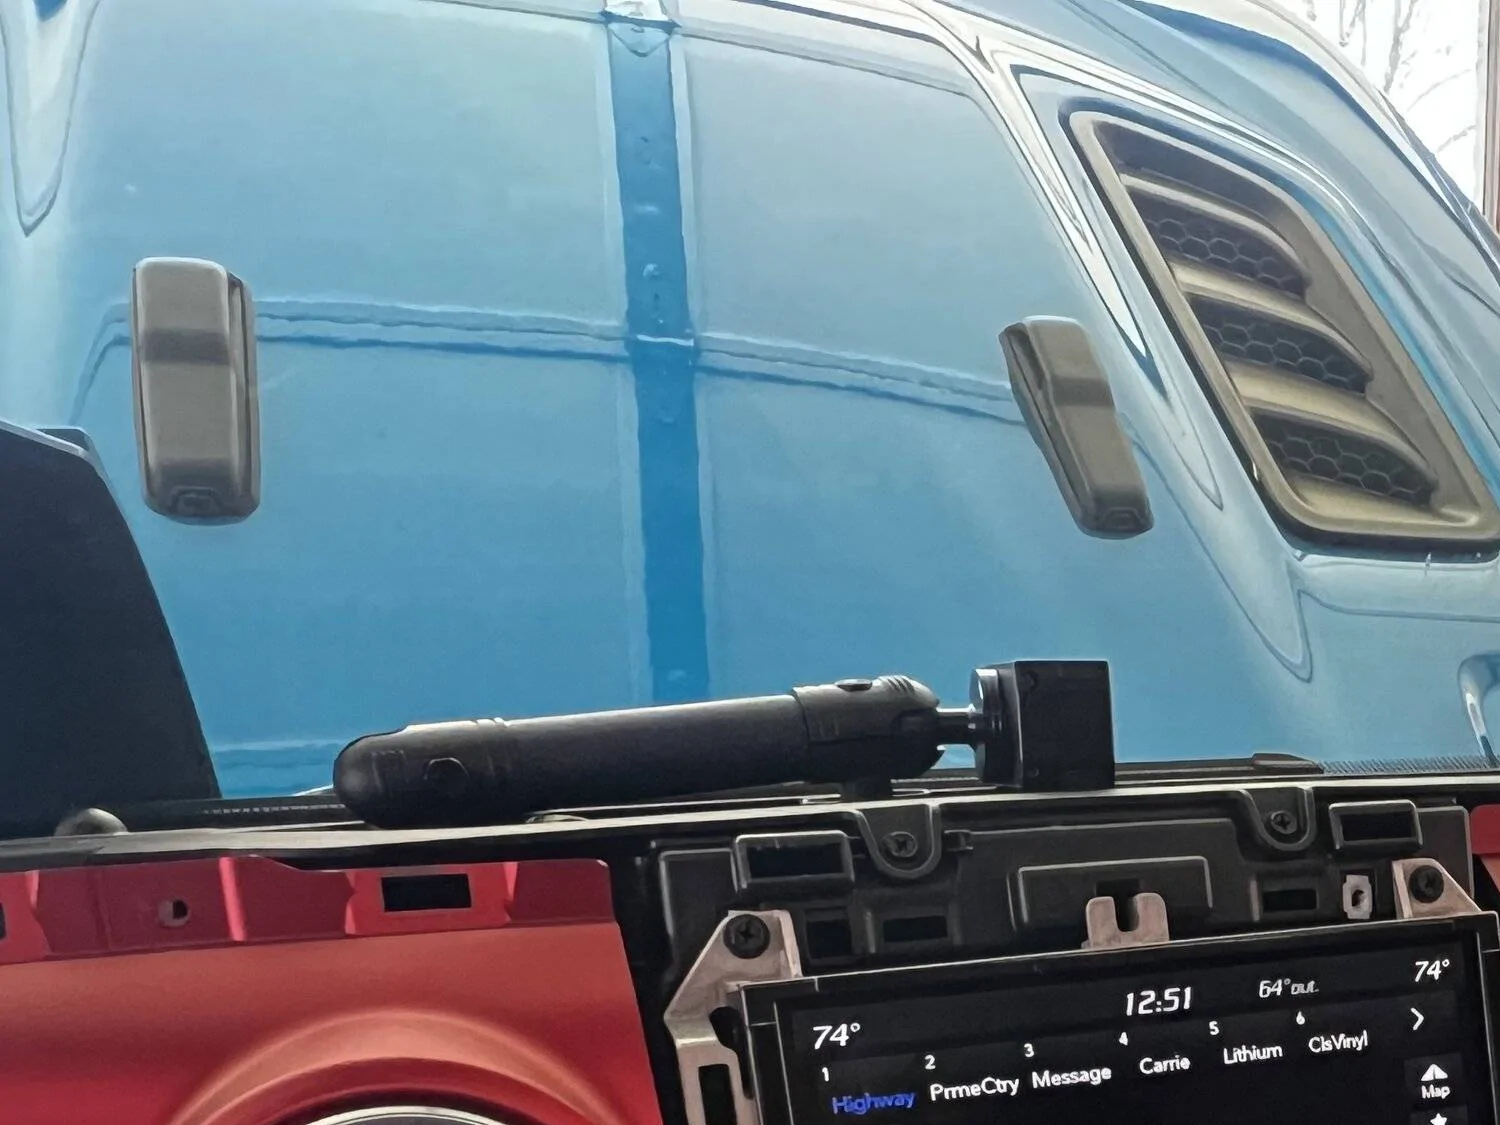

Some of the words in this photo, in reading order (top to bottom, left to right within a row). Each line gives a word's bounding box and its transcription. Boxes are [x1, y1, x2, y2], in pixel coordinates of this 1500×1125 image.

[1415, 959, 1449, 982] 74°
[1127, 987, 1191, 1015] 12:51
[1296, 1012, 1305, 1024] 6
[813, 1023, 860, 1049] 74°
[1209, 1021, 1219, 1035] 5
[1119, 1032, 1128, 1045] 4
[1024, 1043, 1034, 1057] 3
[1224, 1045, 1282, 1064] Lithium
[925, 1055, 935, 1069] 2
[1140, 1055, 1190, 1074] Carrie
[822, 1067, 829, 1081] 1
[1032, 1068, 1111, 1088] Message
[930, 1077, 1019, 1101] PrmeCtry
[1422, 1084, 1450, 1099] Map
[832, 1093, 914, 1115] Highway
